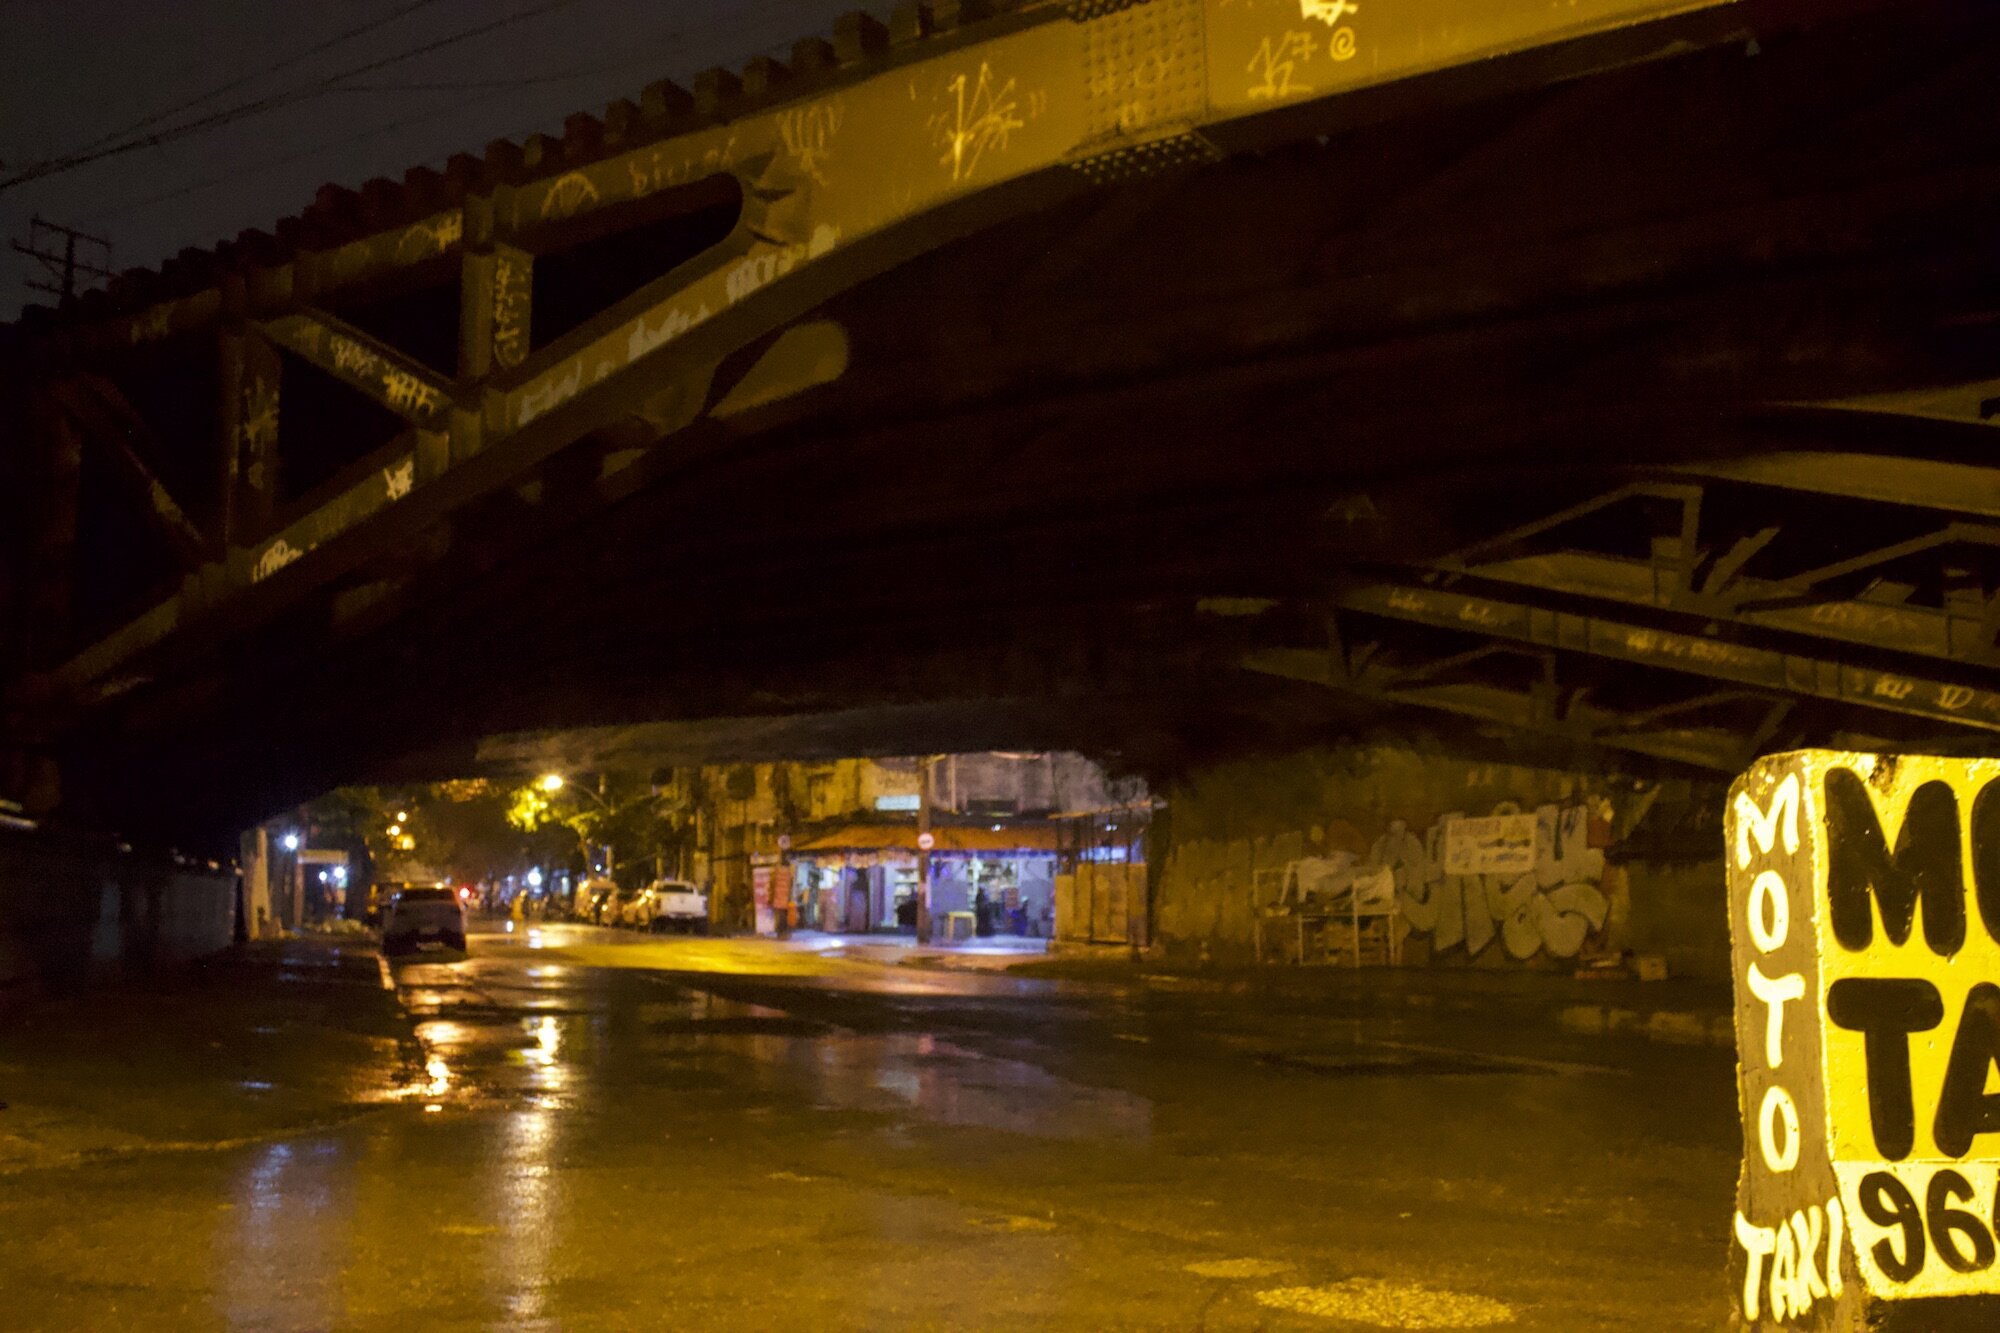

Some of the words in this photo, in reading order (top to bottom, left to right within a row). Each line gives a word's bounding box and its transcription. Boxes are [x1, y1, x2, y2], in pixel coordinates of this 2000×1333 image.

[1735, 772, 1805, 1173] MOTO
[1734, 1195, 1843, 1323] TAXI
[1859, 1169, 2000, 1283] 96
